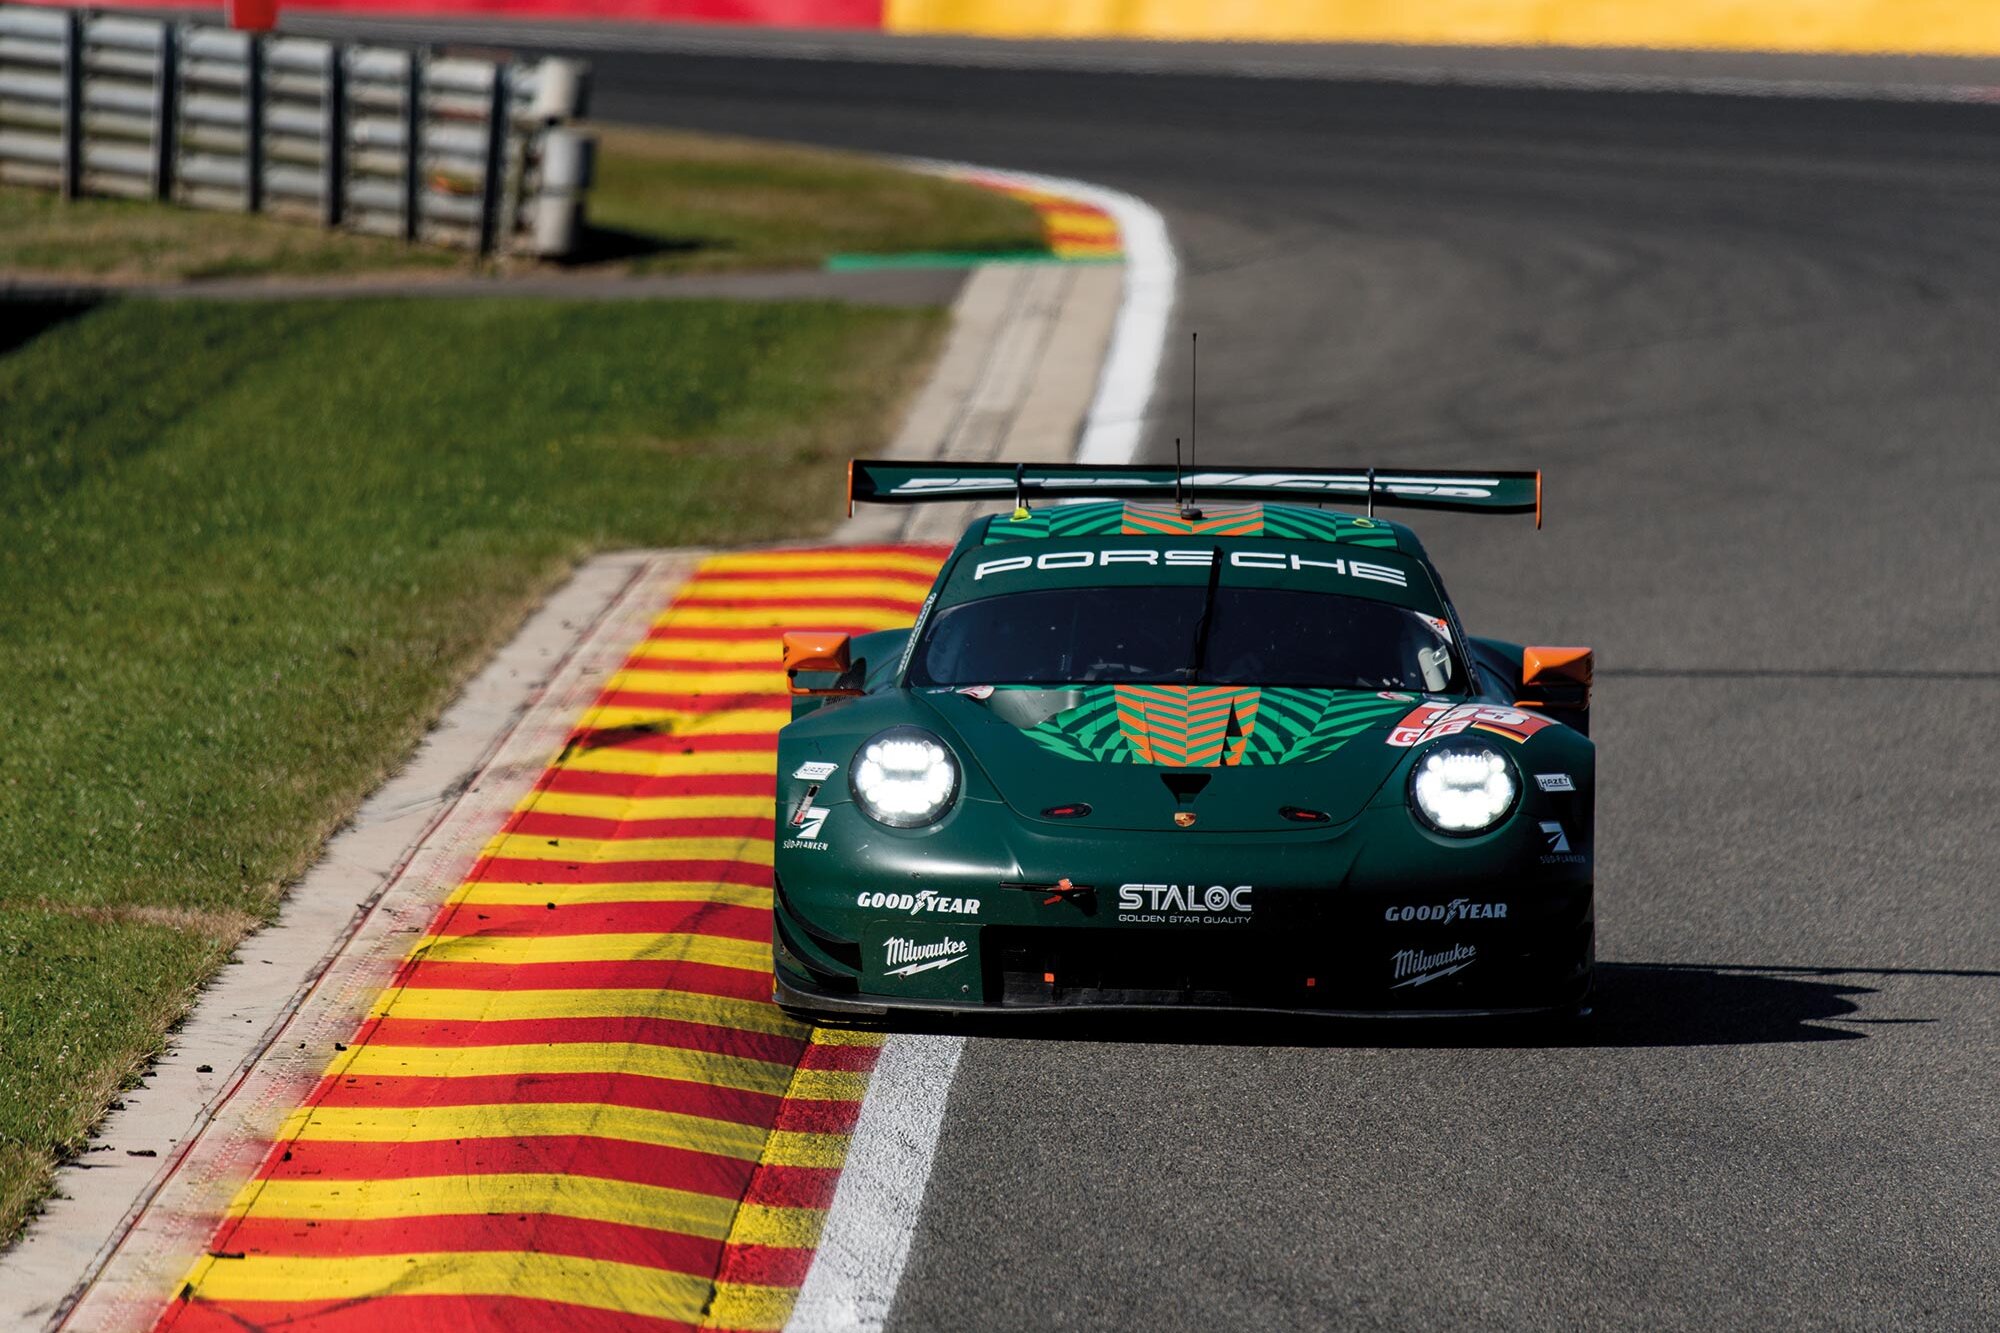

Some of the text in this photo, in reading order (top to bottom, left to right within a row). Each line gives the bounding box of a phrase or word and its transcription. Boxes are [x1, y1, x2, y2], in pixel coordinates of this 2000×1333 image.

[974, 550, 1408, 587] PORSCHE
[857, 891, 981, 915] GOODYEAR
[1118, 884, 1253, 912] STALOC
[1384, 899, 1508, 924] GOODYEAR
[1118, 914, 1252, 924] GOLDEN STAR QUALITY
[883, 936, 968, 967] Milwaukee
[1390, 943, 1477, 979] Milwaukee
